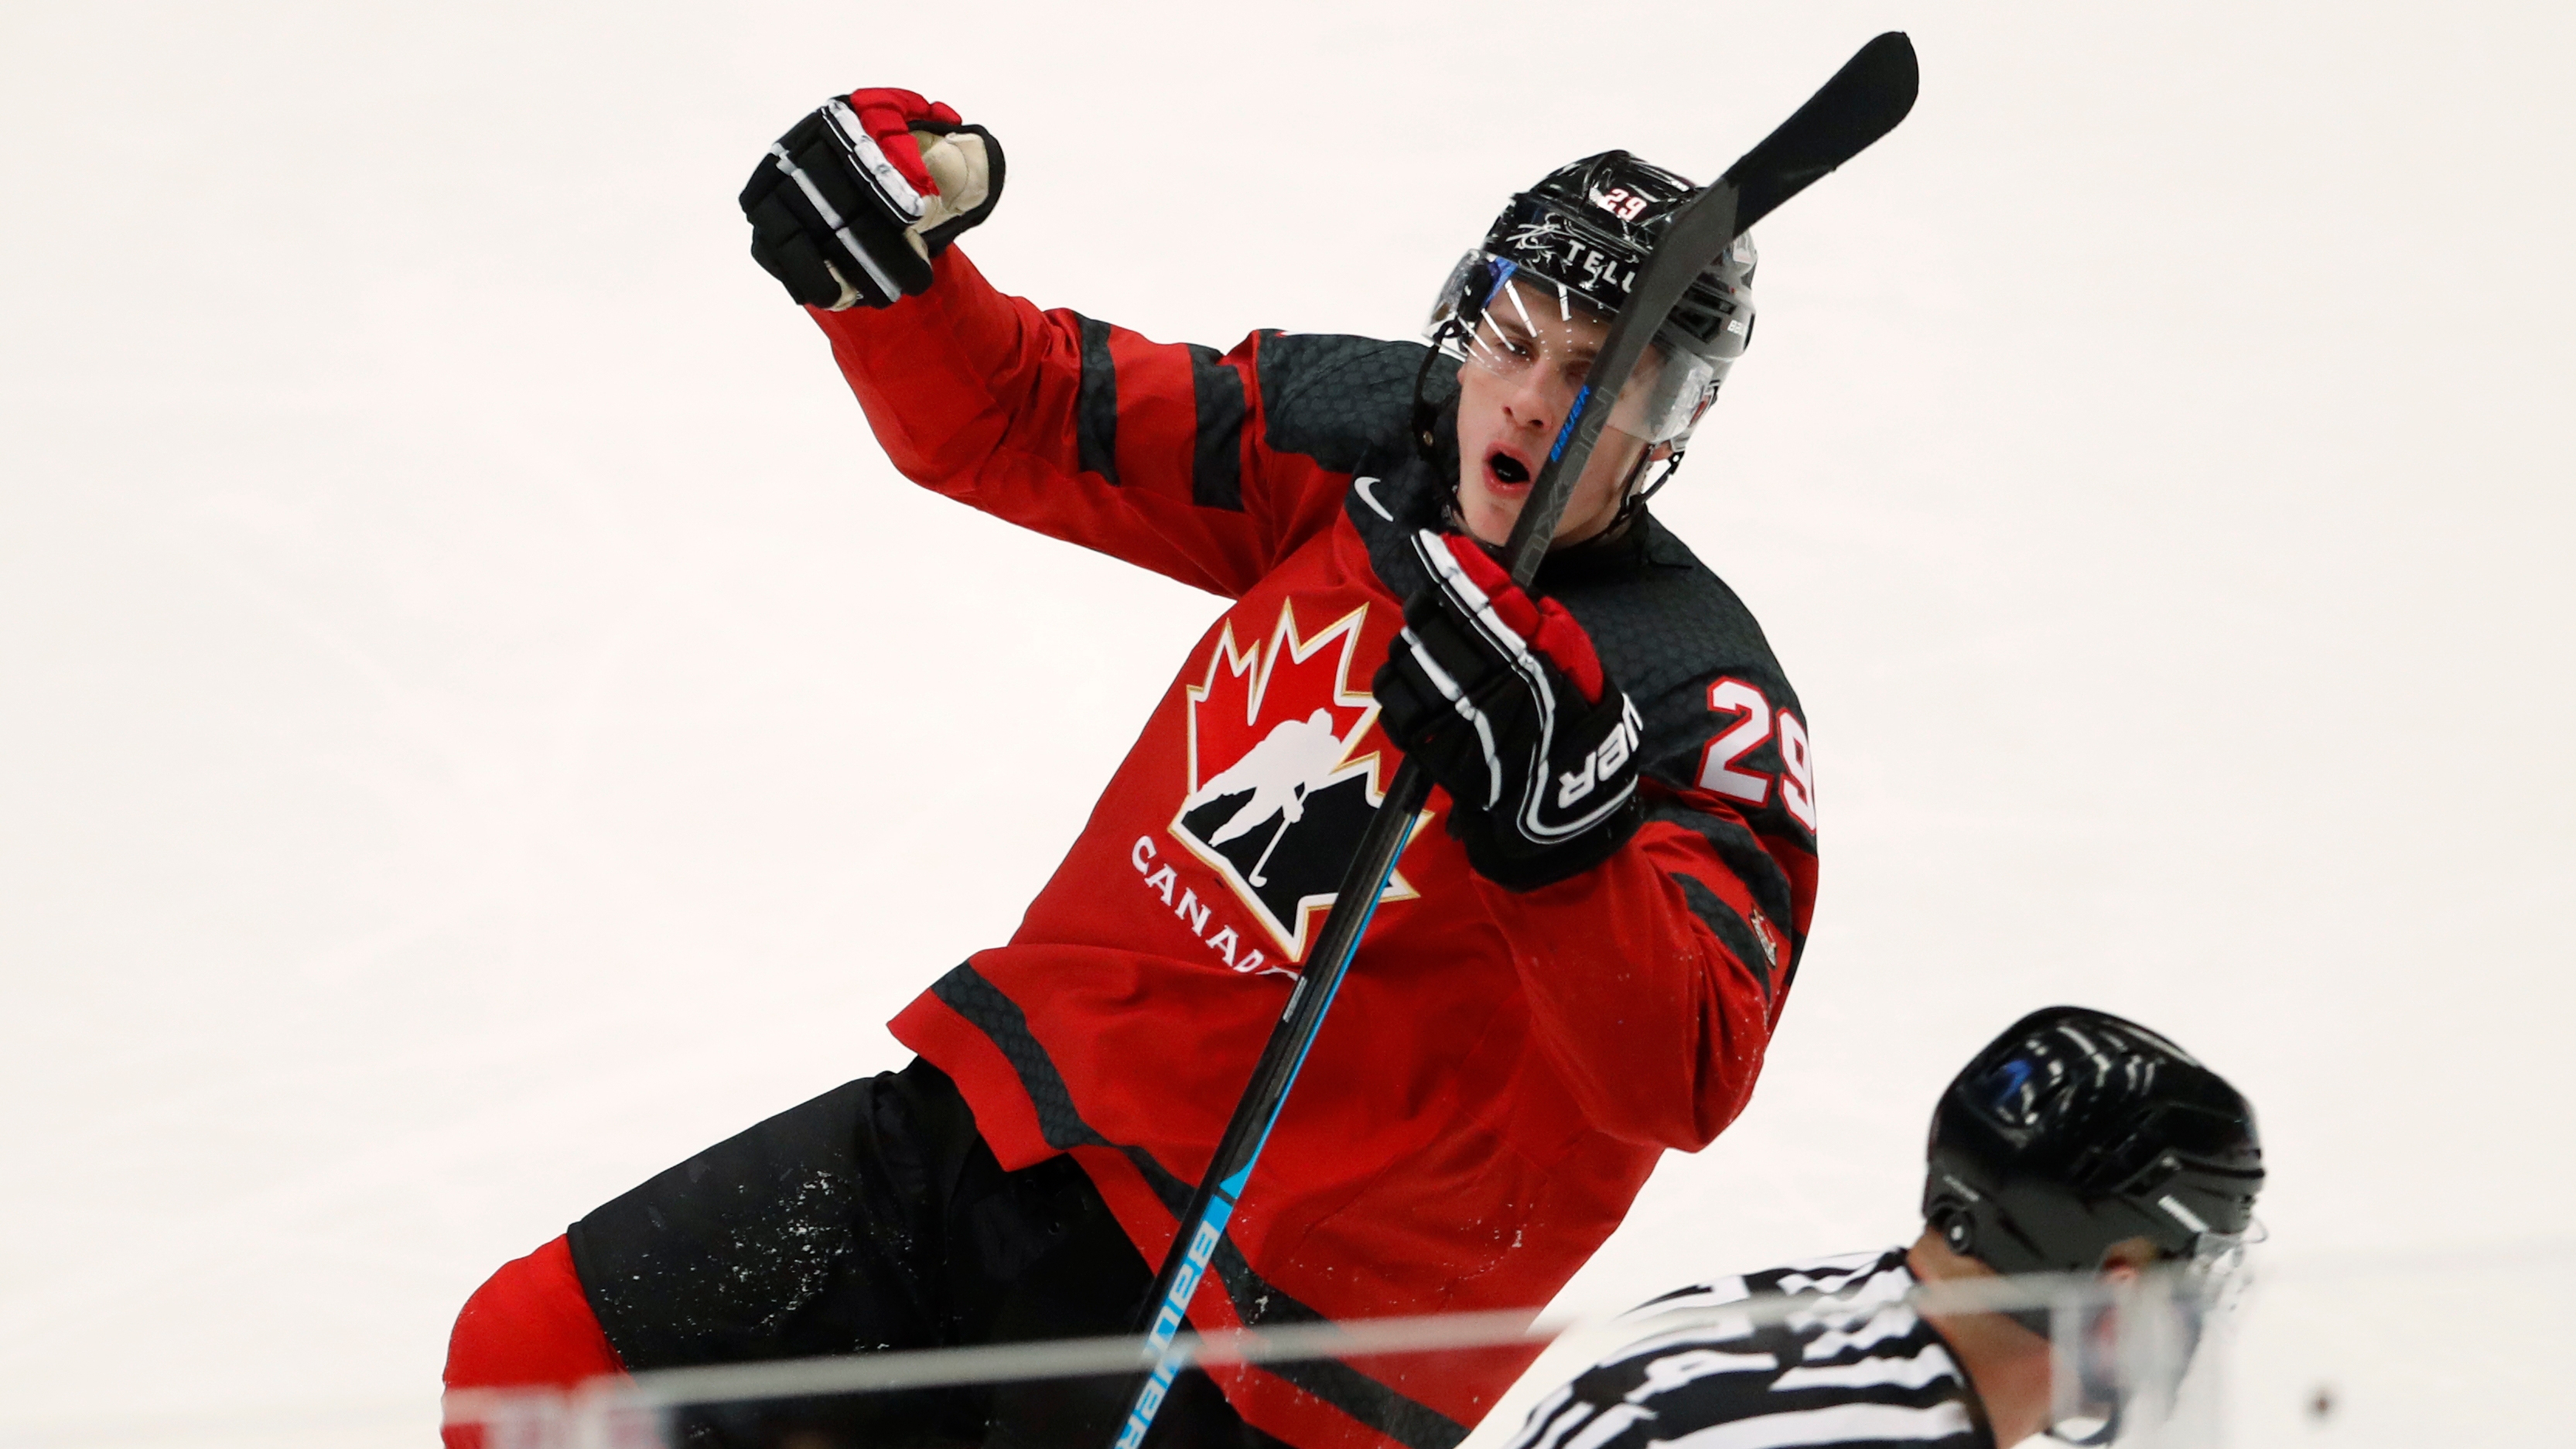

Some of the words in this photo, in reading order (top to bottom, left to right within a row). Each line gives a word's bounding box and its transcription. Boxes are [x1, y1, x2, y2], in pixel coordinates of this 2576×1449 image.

[1597, 188, 1648, 222] 29
[1566, 239, 1636, 294] TELU
[1557, 692, 1644, 809] UER
[1693, 675, 1817, 836] 29
